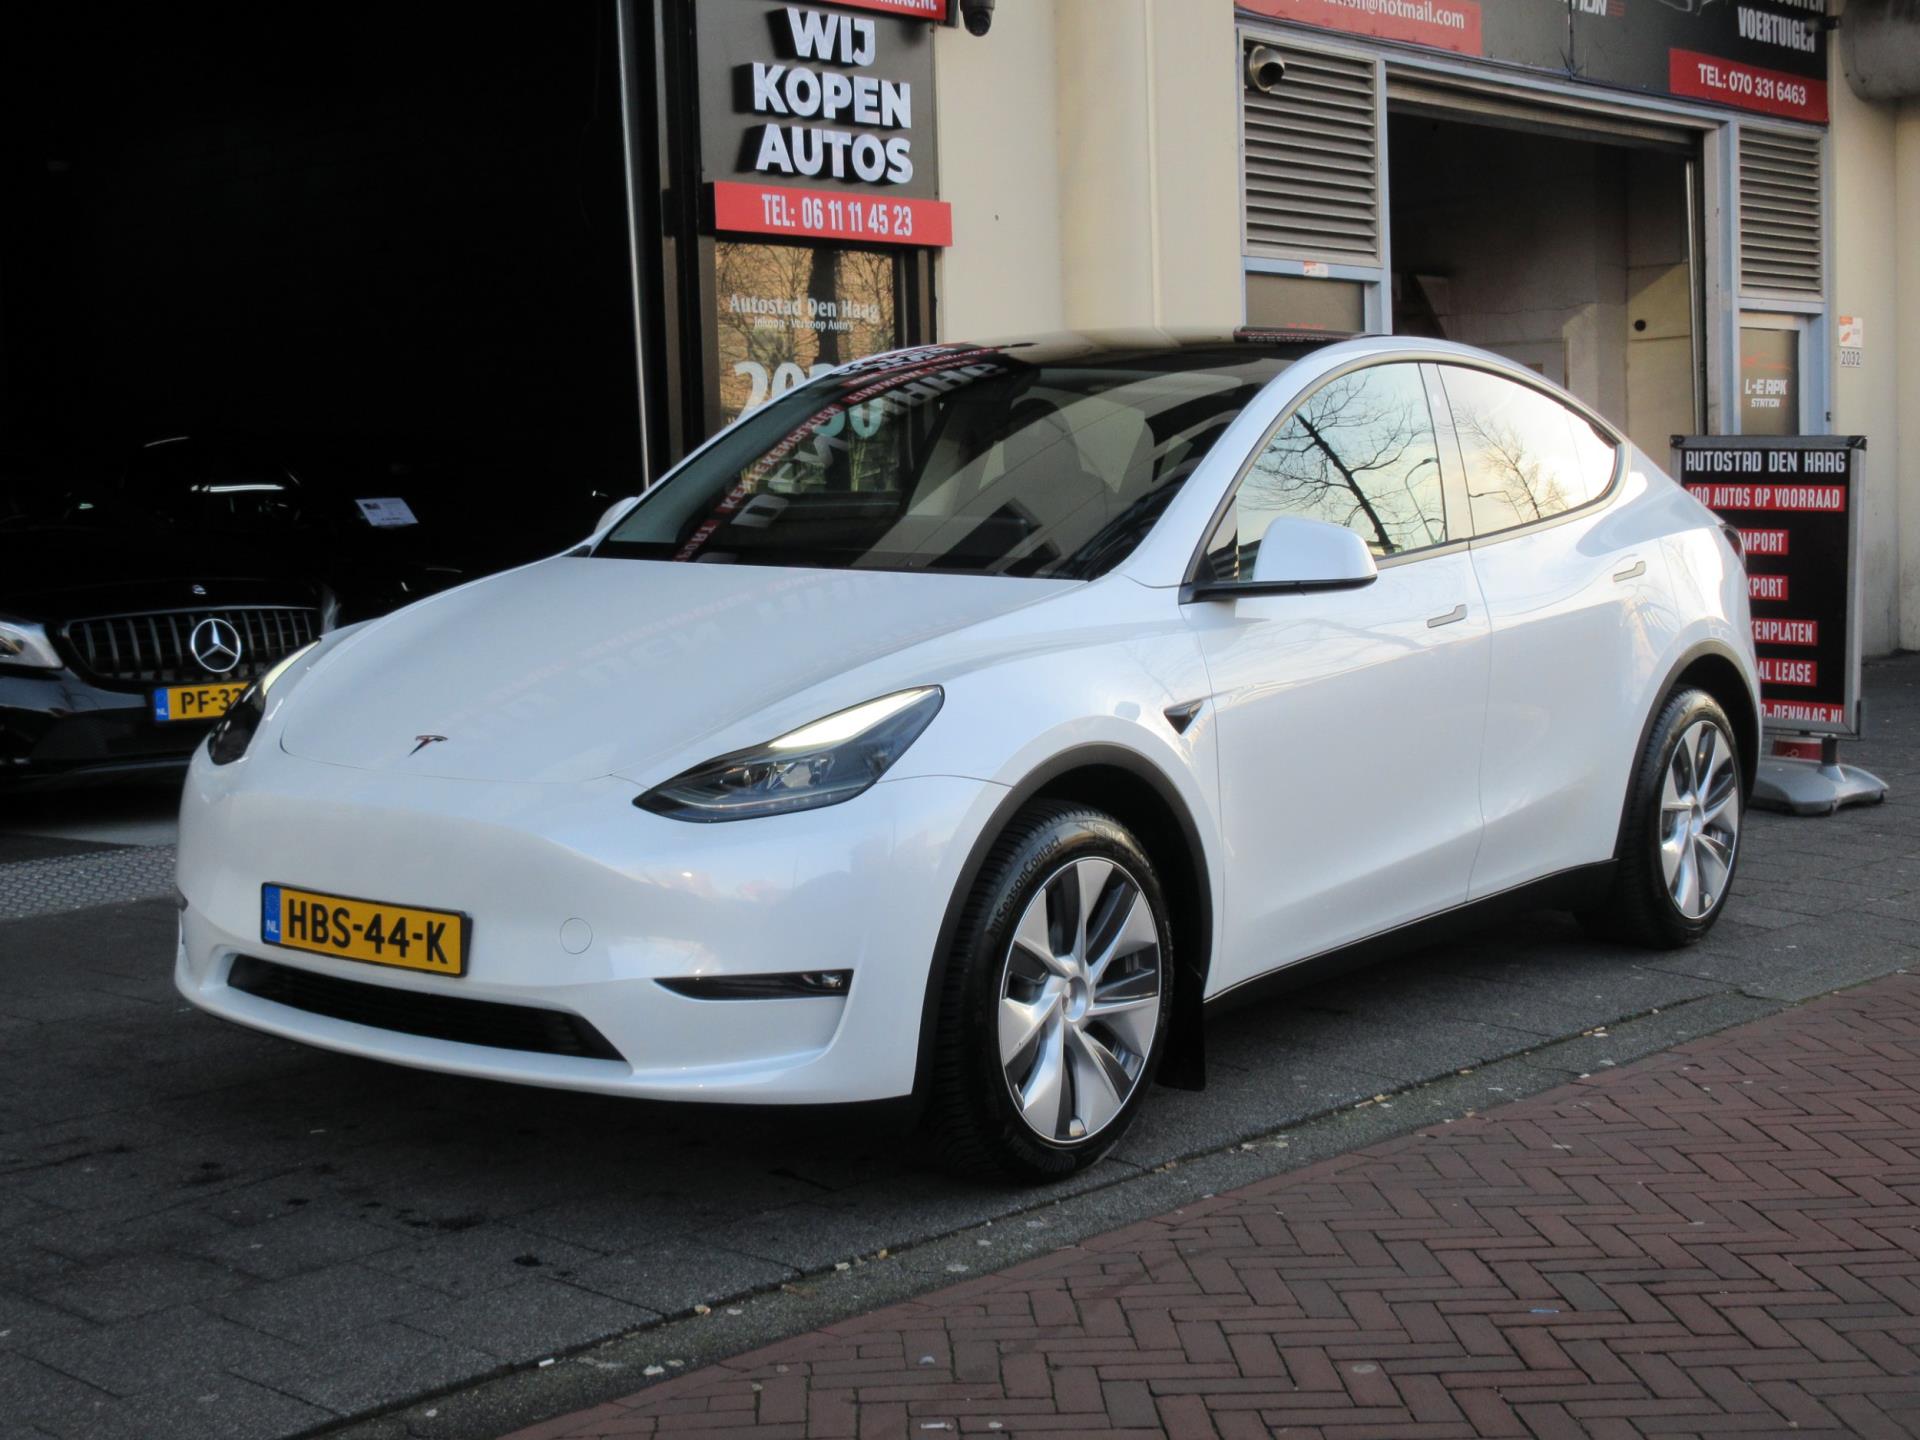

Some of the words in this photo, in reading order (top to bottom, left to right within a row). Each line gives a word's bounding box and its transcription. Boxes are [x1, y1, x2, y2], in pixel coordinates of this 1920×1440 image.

[786, 7, 876, 67] WIJ
[752, 62, 912, 129] KOPEN
[1698, 63, 1727, 88] TEL:
[1729, 70, 1752, 94] 070
[1755, 76, 1775, 99] 331
[1777, 81, 1806, 106] 6463
[755, 123, 914, 184] AUTOS
[761, 193, 796, 227] TEL:
[801, 197, 824, 230] 06
[828, 200, 844, 231] 11
[848, 202, 863, 232] 11
[868, 203, 889, 235] 45
[893, 206, 913, 236] 23
[730, 294, 801, 316] Autostad
[808, 298, 837, 317] Den
[842, 300, 881, 324] Haag
[1685, 451, 1762, 472] AUTOSTAD
[1768, 451, 1798, 472] DEN
[1804, 452, 1846, 473] HAAG
[1713, 488, 1750, 507] AUTOS
[1754, 488, 1771, 507] OP
[1774, 488, 1840, 508] VOORRAAD
[1741, 532, 1784, 551] MPORT
[1775, 662, 1812, 683] LEASE
[266, 919, 279, 934] NL
[288, 898, 448, 964] HBS-44-K
